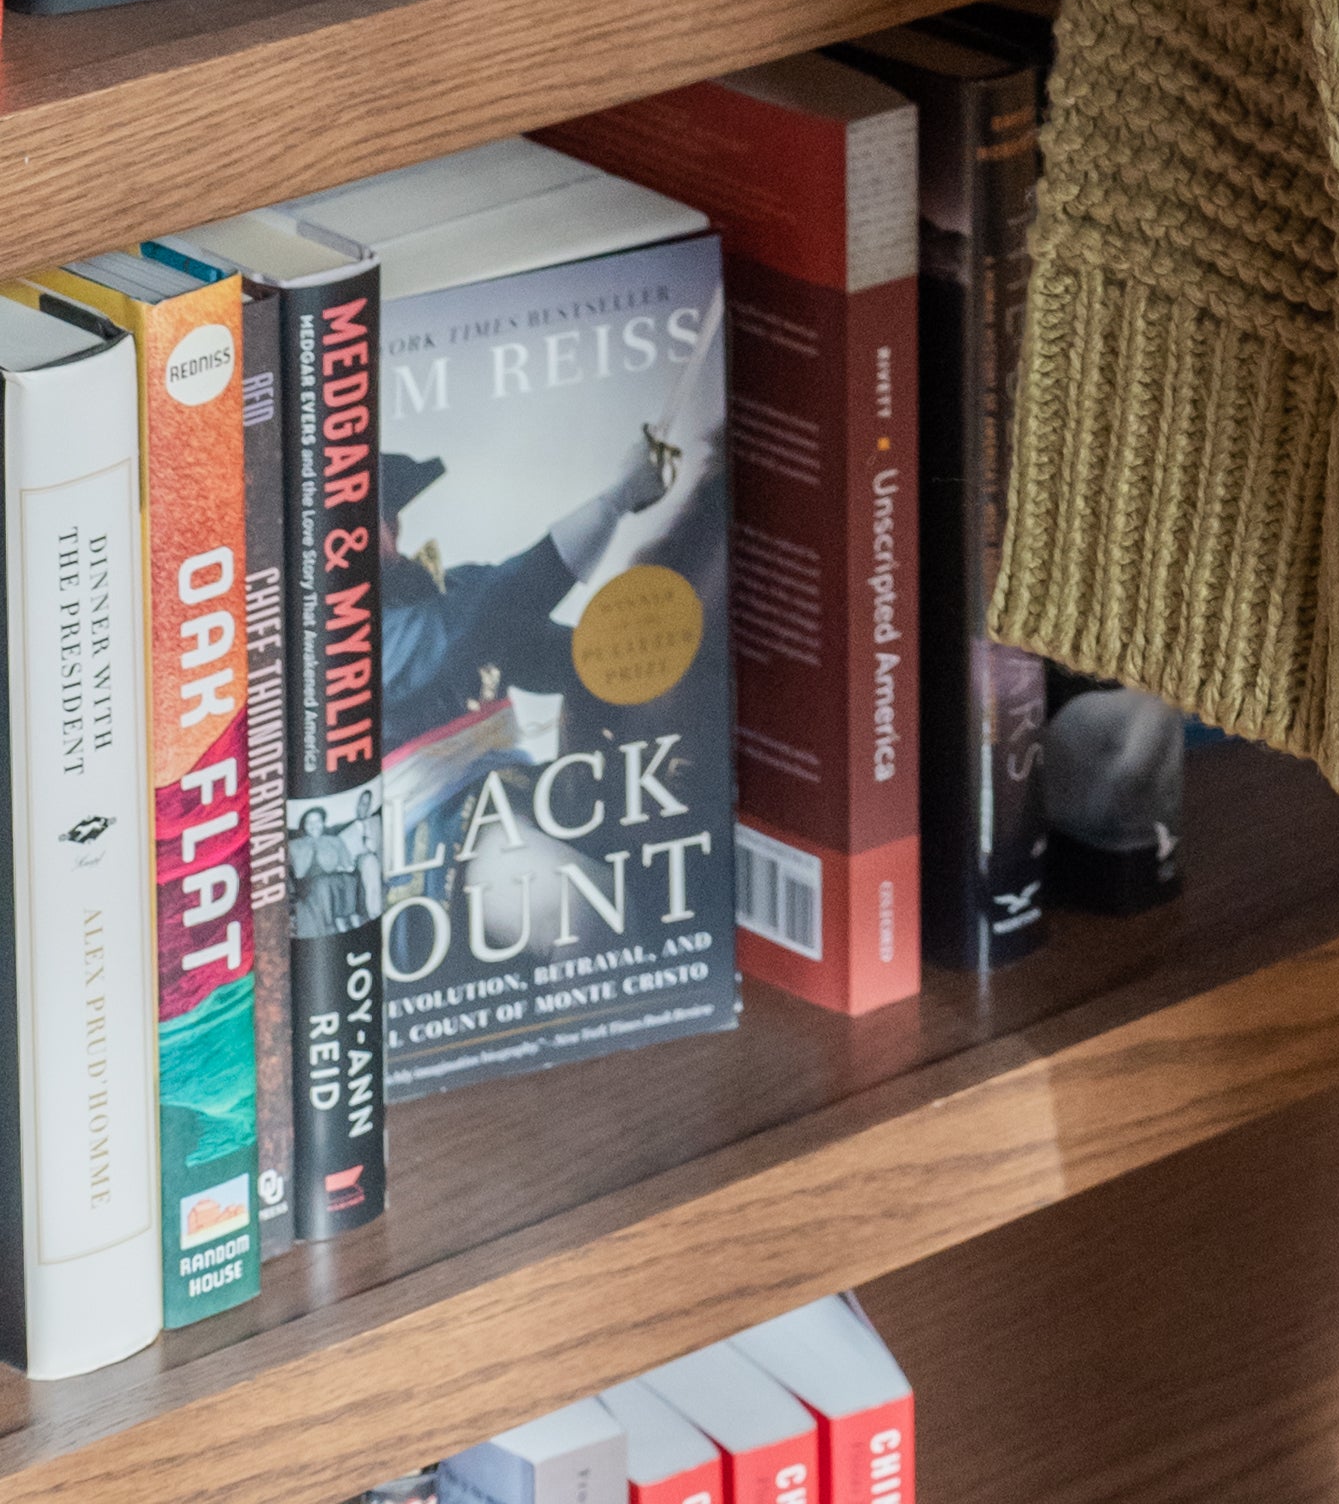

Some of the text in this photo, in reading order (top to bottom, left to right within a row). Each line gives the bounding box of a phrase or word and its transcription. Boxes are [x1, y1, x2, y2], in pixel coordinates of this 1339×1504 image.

[169, 346, 232, 384] REDNISS
[243, 371, 274, 427] REID
[489, 307, 701, 401] REISS
[300, 314, 319, 773] MEDGAR EVERS and the Love Story That Awakened America
[322, 297, 373, 774] MEDGAR & MYRLIE
[58, 525, 85, 778] THE PRESIDENT
[88, 535, 114, 753] DINNER WITH
[867, 468, 901, 783] Unscripted America
[177, 546, 242, 972] OAK FLAT
[245, 566, 287, 910] CHIEF THUNDERWATER
[382, 733, 690, 881] LACK
[381, 830, 711, 983] OUNT
[387, 931, 713, 1020] EVOLUTION, BETRAYAL, AND
[82, 908, 112, 1211] ALEX PRUD'HOMME
[309, 1011, 342, 1111] REID
[346, 951, 375, 1138] JOY-ANN
[409, 1008, 492, 1044] COUNT
[496, 1000, 529, 1024] OF
[535, 980, 618, 1015] MONTE
[623, 961, 709, 995] CRISTO
[179, 1233, 251, 1277] RANDOM
[188, 1259, 243, 1298] HOUSE
[869, 1428, 902, 1504] CHI
